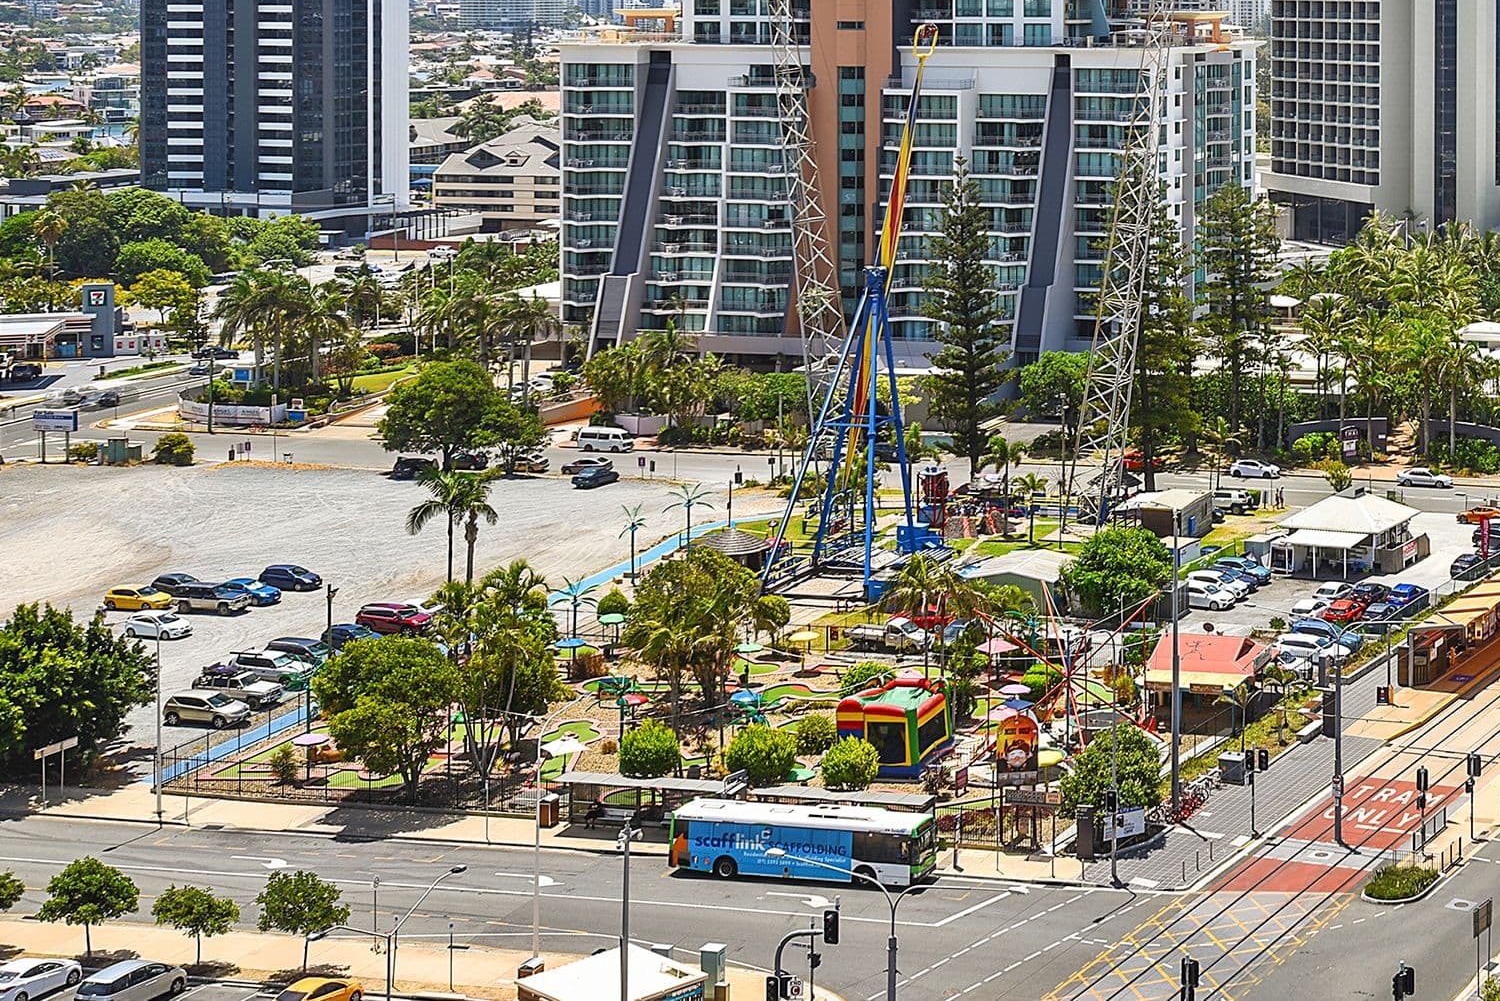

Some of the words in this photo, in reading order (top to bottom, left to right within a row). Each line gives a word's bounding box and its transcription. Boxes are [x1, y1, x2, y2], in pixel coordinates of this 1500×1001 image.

[1323, 805, 1420, 827] ONLY
[695, 832, 766, 851] scafflink
[769, 840, 847, 856] SCAFFOLDING
